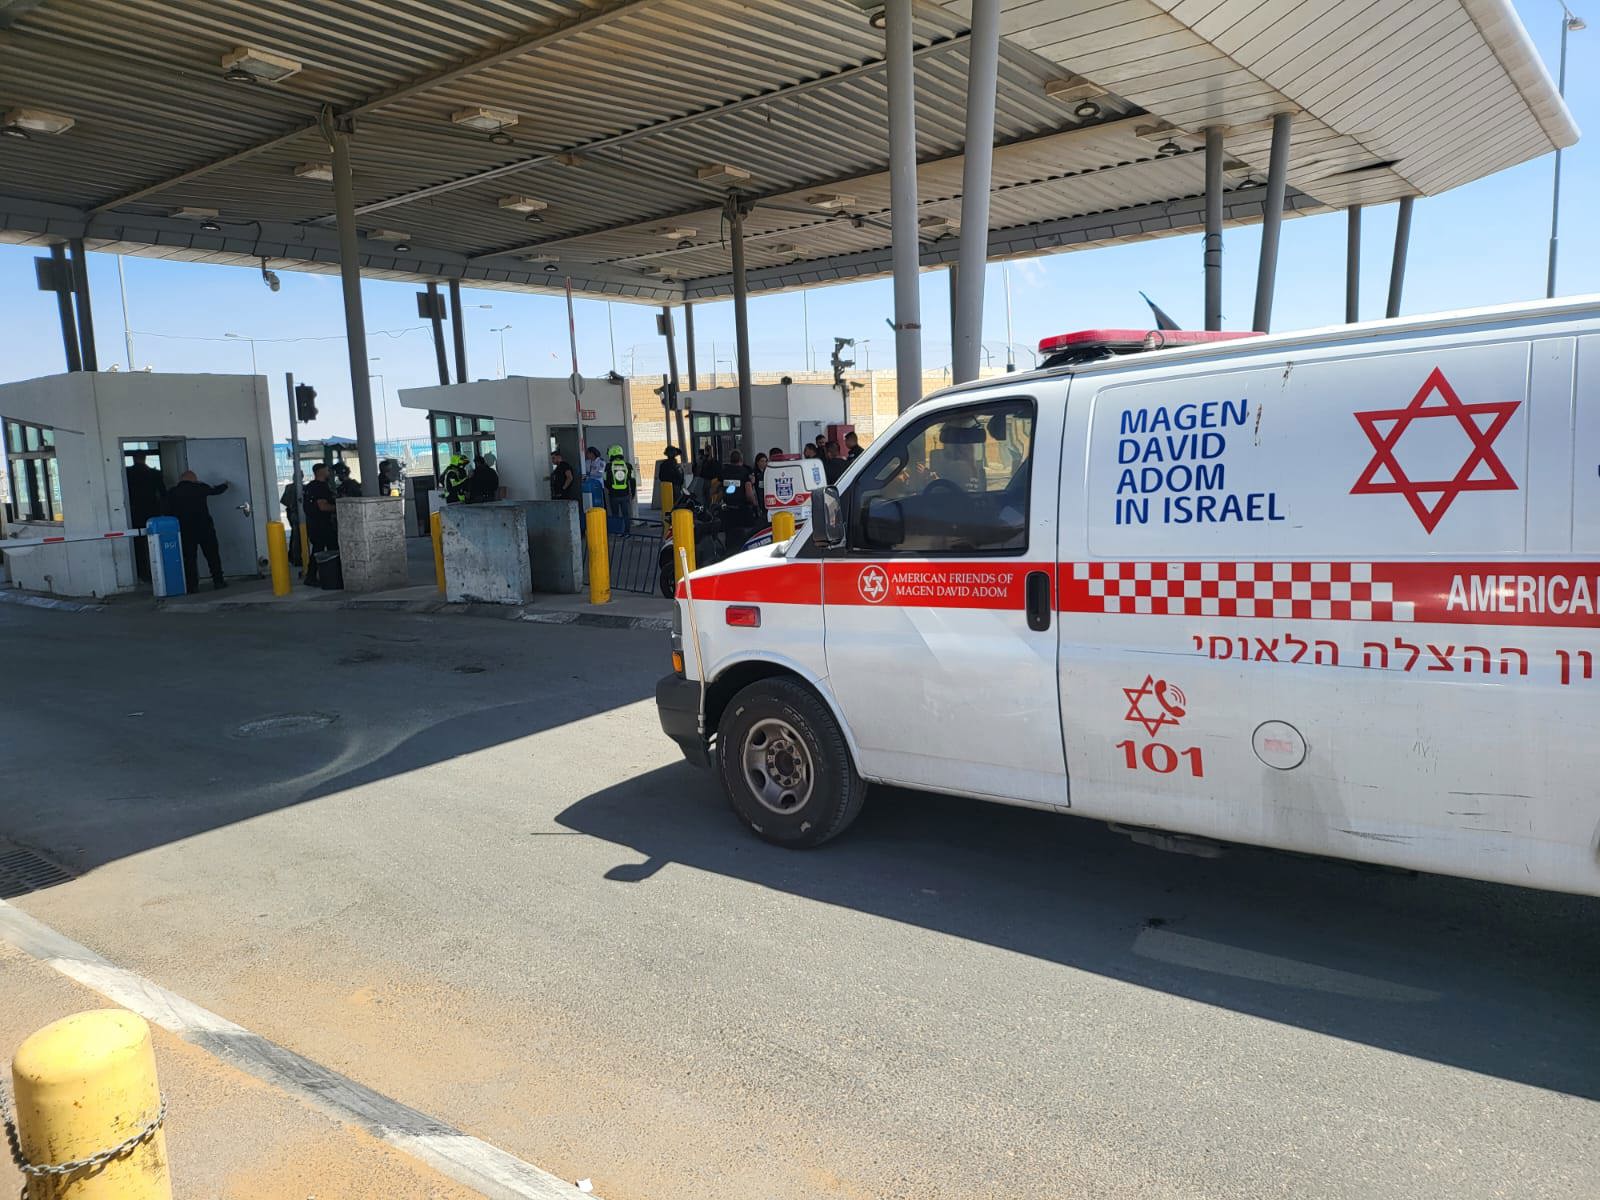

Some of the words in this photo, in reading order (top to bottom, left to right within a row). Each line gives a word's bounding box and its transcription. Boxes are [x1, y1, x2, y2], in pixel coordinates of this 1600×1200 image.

[1120, 399, 1248, 435] MAGEN
[1118, 432, 1226, 465] DAVID
[1116, 463, 1225, 495] ADOM
[1115, 497, 1149, 525] IN
[1164, 492, 1285, 524] ISRAEL
[891, 573, 947, 584] AMERICAN
[949, 573, 996, 584] FRIENDS
[997, 573, 1014, 584] OF
[895, 585, 934, 597] MAGEN
[936, 586, 970, 597] DAVID
[971, 586, 1008, 598] ADOM
[1446, 574, 1600, 615] AMERICA
[1192, 633, 1339, 666] הלאומי
[1363, 638, 1528, 676] ההצלה
[1115, 739, 1204, 778] 101
